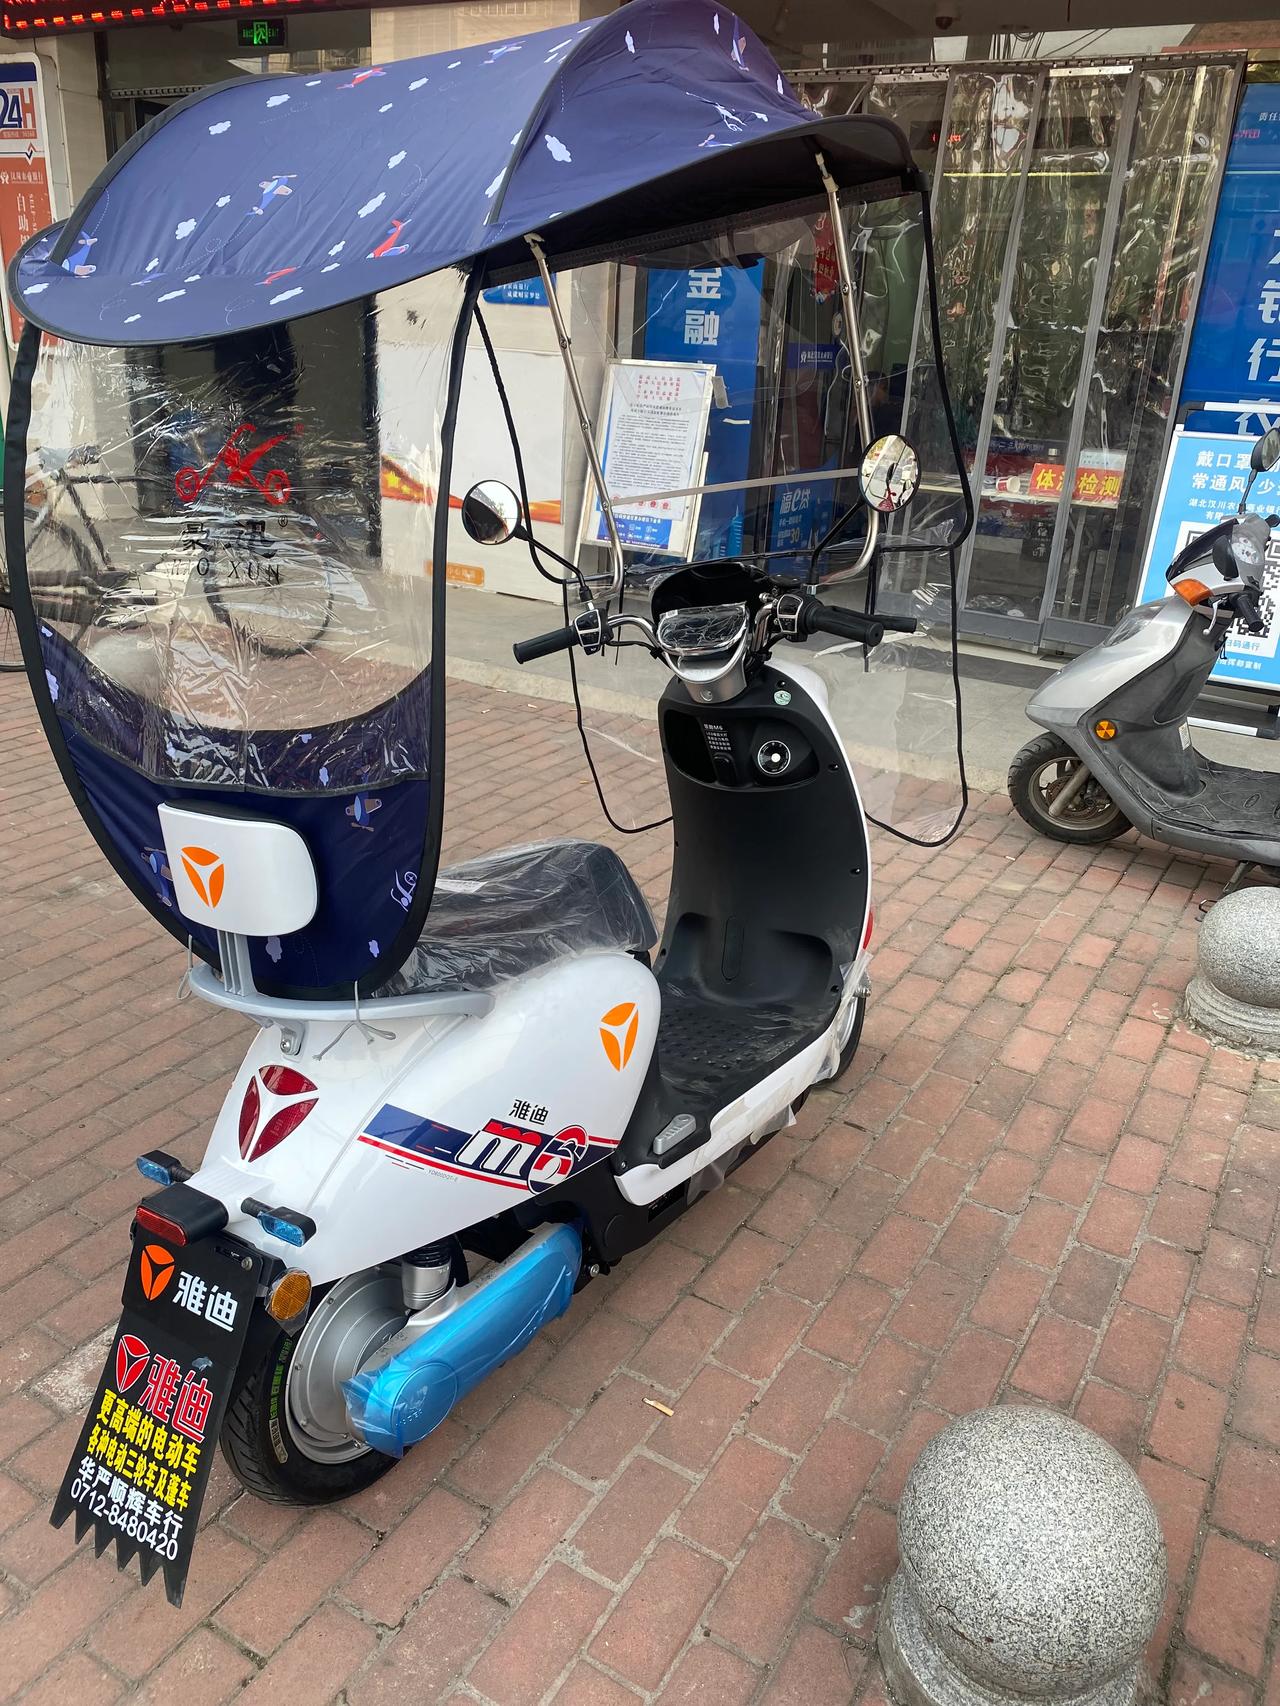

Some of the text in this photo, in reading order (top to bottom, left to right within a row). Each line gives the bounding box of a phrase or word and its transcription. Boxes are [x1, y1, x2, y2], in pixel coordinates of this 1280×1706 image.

[1259, 111, 1280, 121] 责任
[1195, 450, 1251, 470] 戴口罩
[1192, 472, 1280, 496] 常通风 少
[1188, 498, 1280, 514] 湖北汉川农商业银
[509, 1099, 549, 1125] 雅迪
[172, 1271, 238, 1332] 雅迪
[138, 1353, 213, 1444] 雅迪
[96, 1388, 202, 1478] 更高端的电动车
[78, 1455, 184, 1540] 华严顺辉车行
[70, 1477, 179, 1562] 0712-8480420
